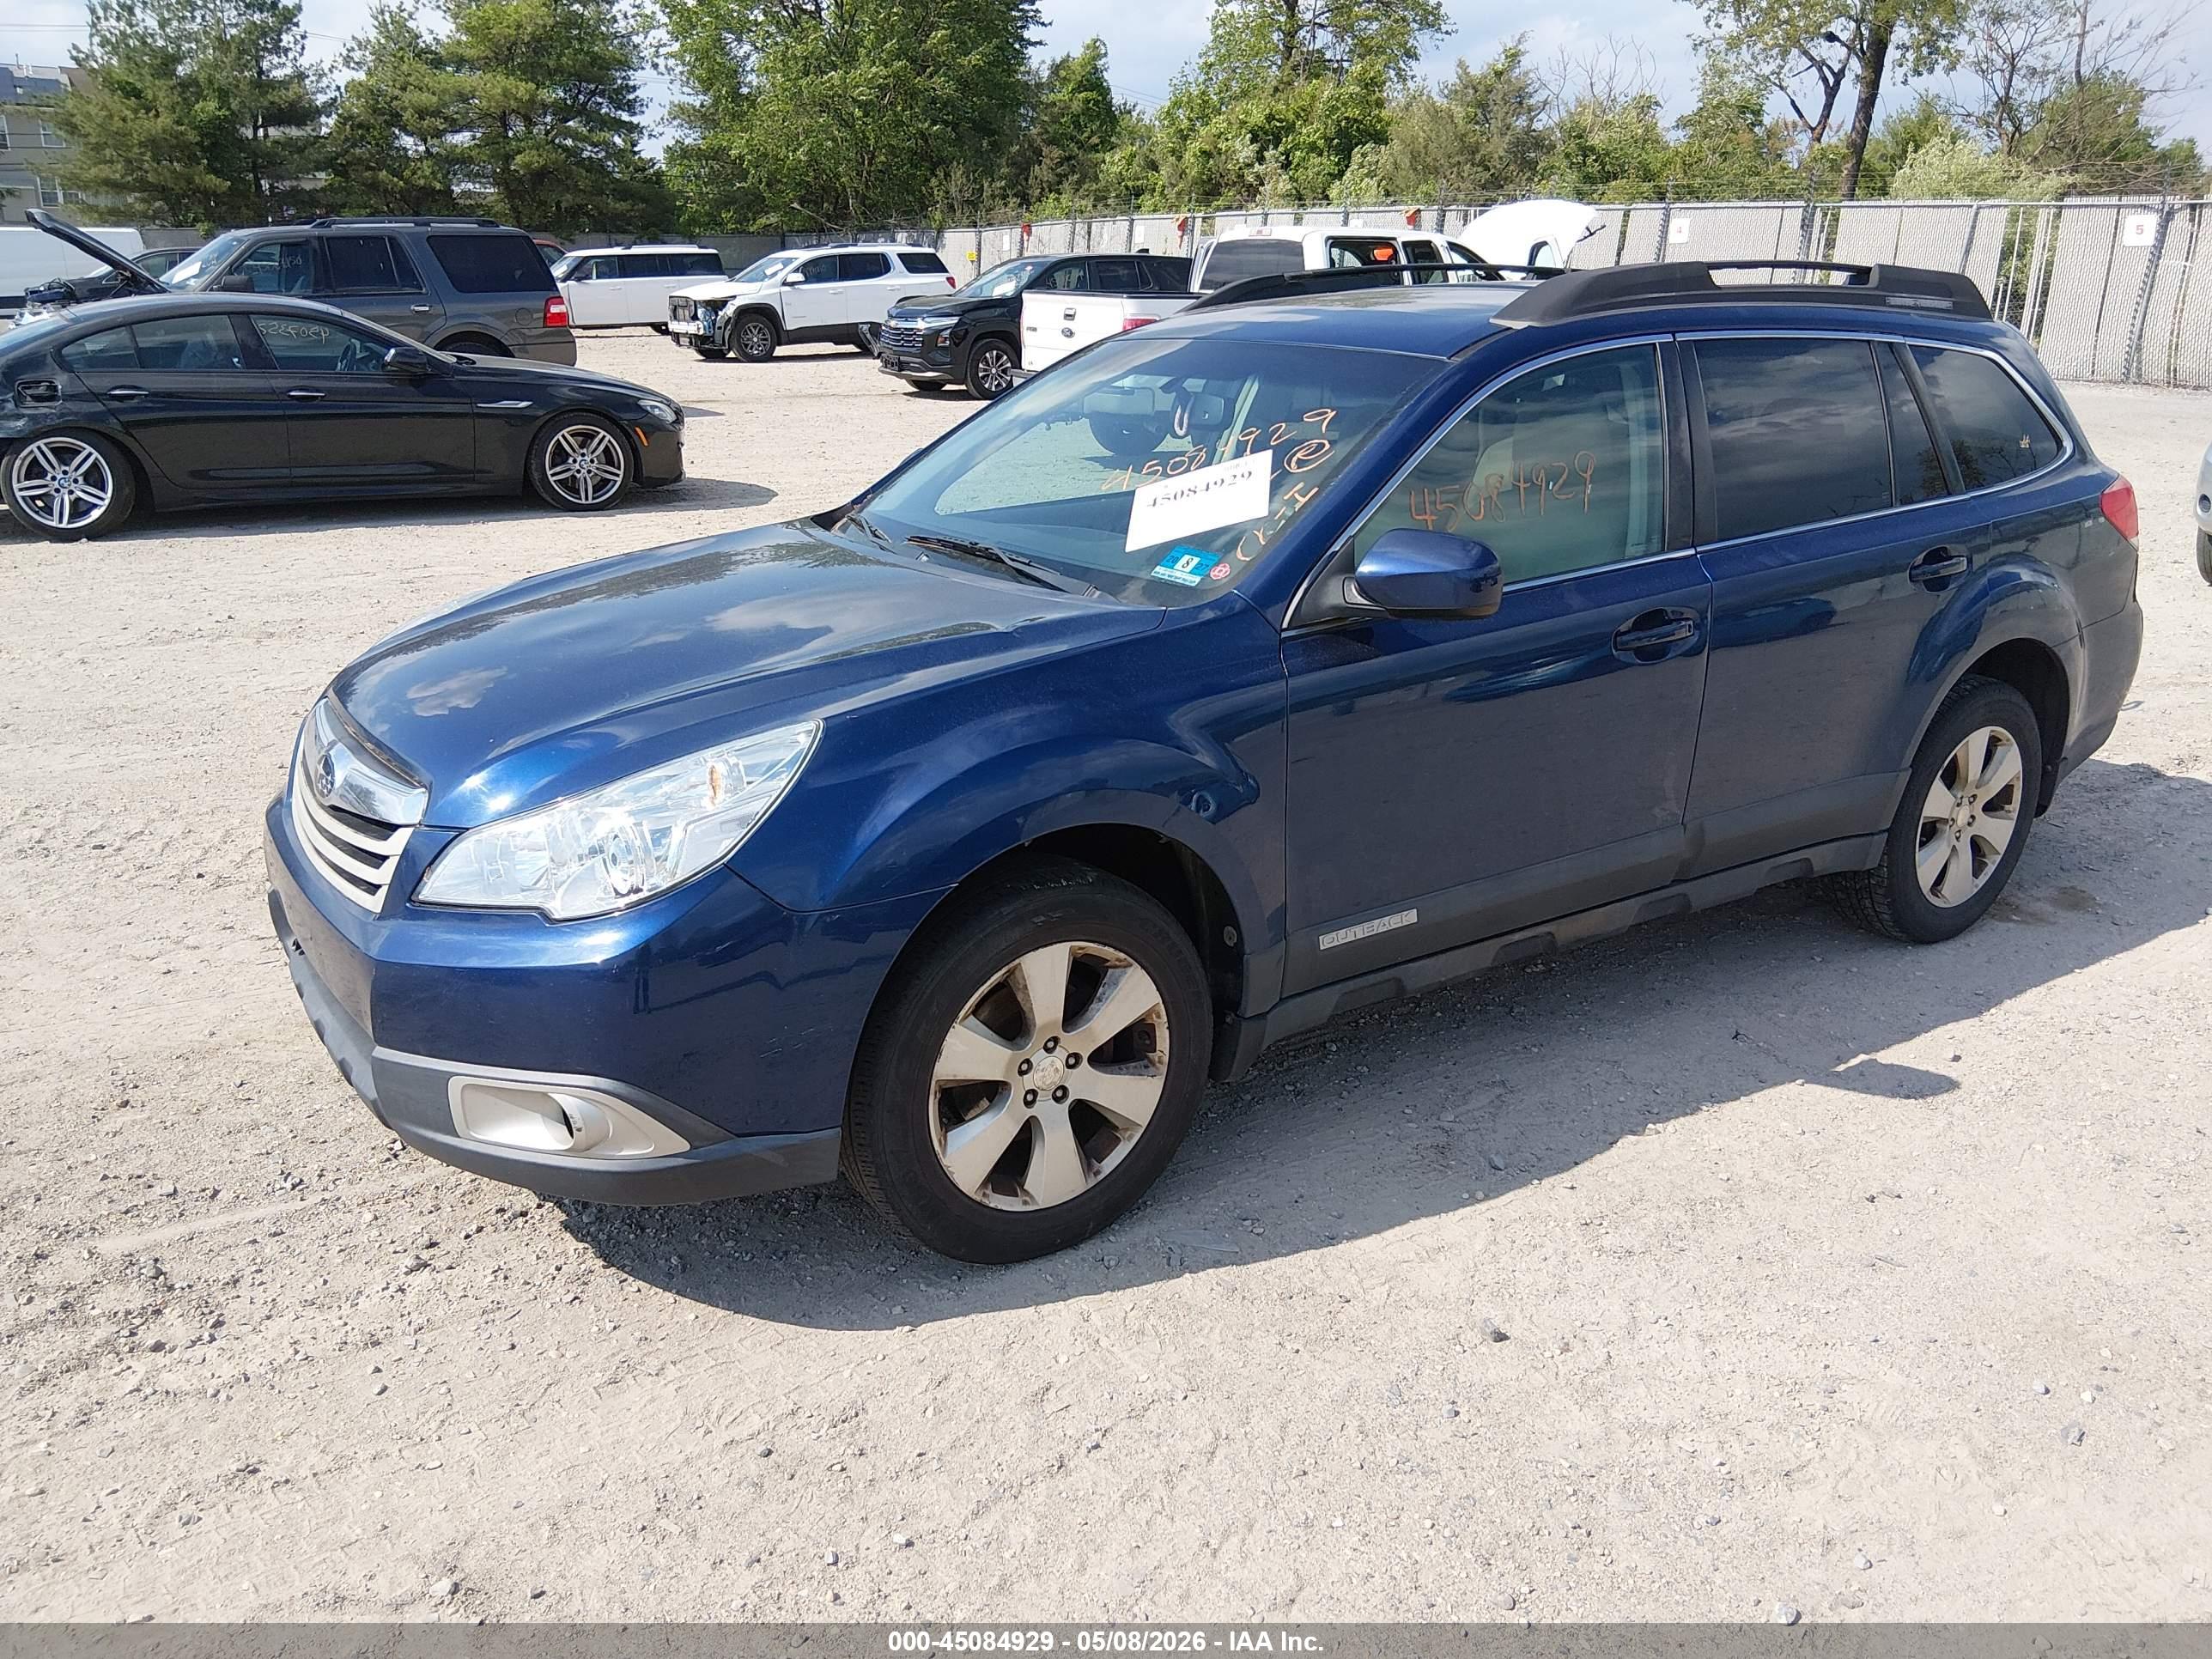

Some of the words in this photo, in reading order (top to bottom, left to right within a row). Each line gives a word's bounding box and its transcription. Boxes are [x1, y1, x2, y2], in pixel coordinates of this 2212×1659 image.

[2136, 224, 2144, 235] 5
[1409, 450, 1595, 533] 45084929
[1181, 557, 1194, 569] 8
[1321, 911, 1412, 948] OUTBACK
